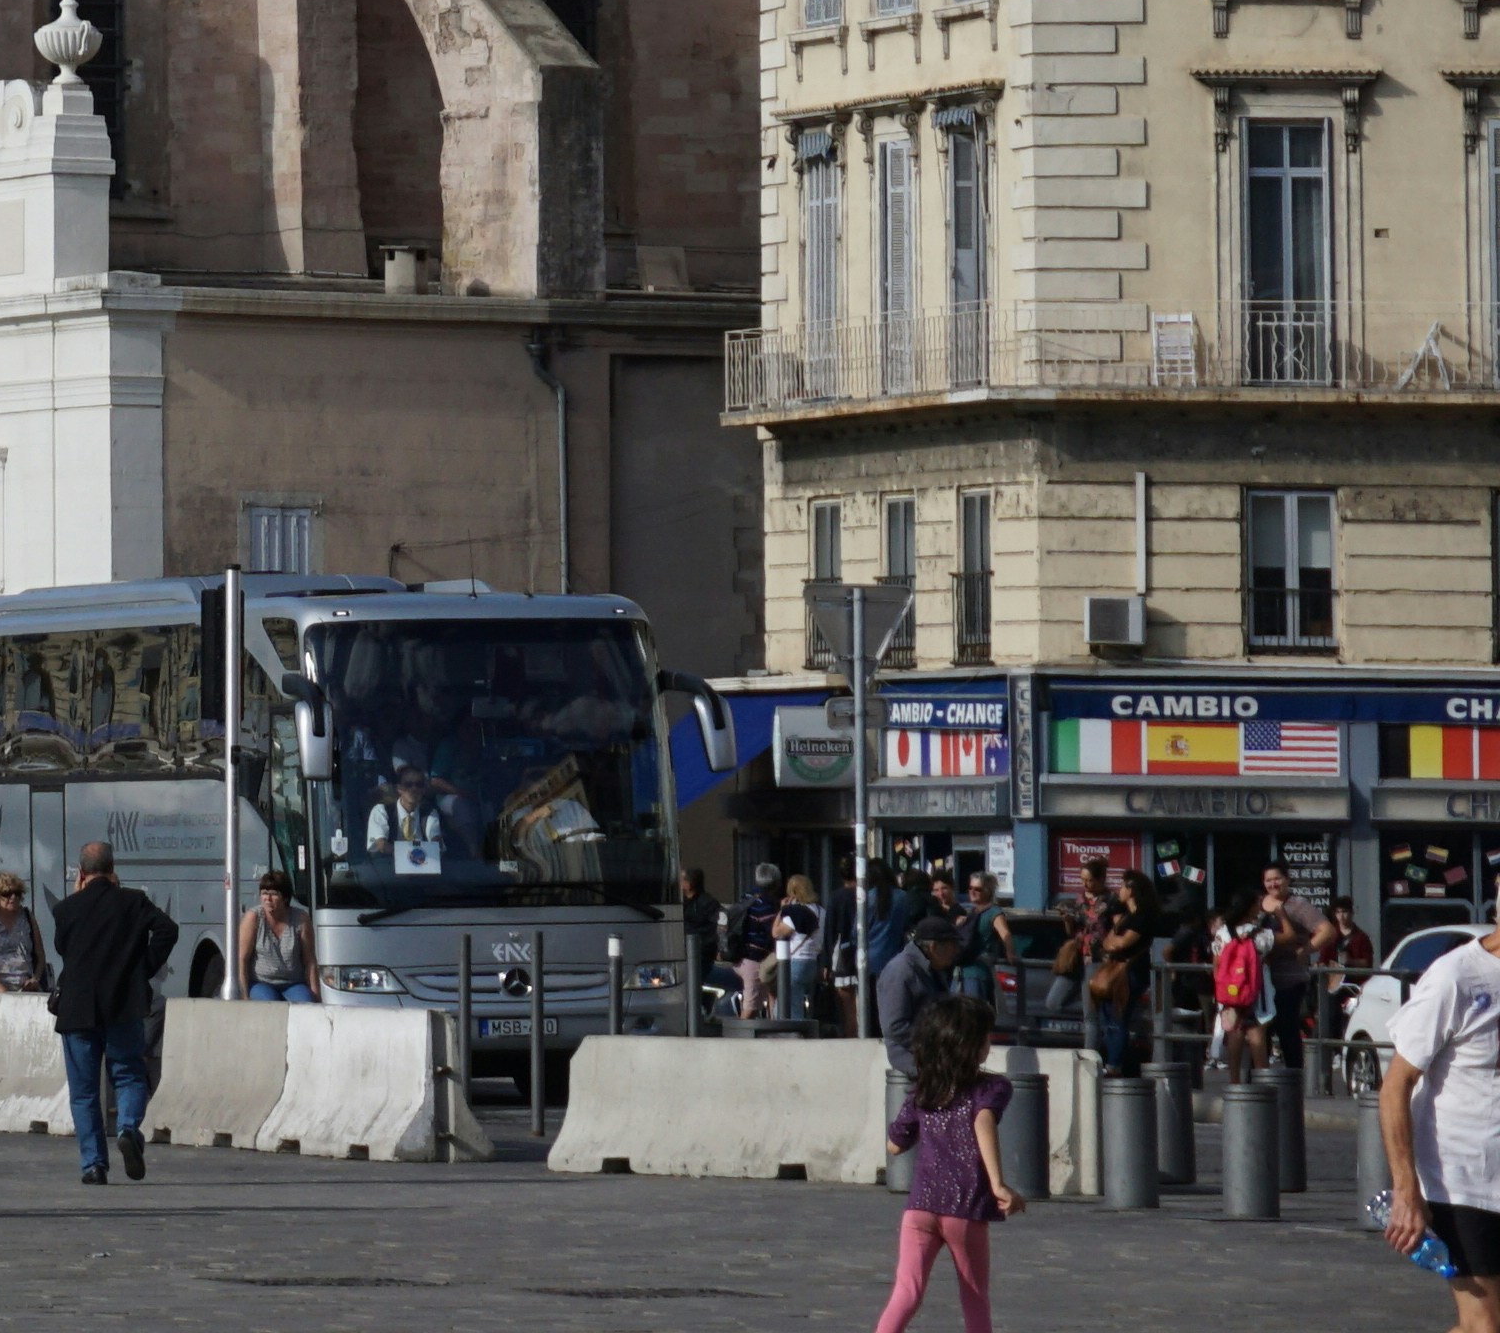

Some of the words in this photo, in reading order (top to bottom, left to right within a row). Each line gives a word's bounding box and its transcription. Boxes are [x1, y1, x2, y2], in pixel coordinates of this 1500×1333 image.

[889, 702, 934, 724] AMBIO
[946, 702, 1004, 725] CHANGE
[1111, 695, 1259, 718] CAMBIO
[1446, 698, 1500, 720] CH
[790, 739, 850, 753] Heineken
[1125, 789, 1269, 815] CAMBIO
[1446, 793, 1500, 819] CH
[1064, 842, 1111, 854] Thomas
[1283, 842, 1329, 851] ACHAT
[1283, 853, 1330, 862] VENTE
[491, 1021, 554, 1034] MSB-0
